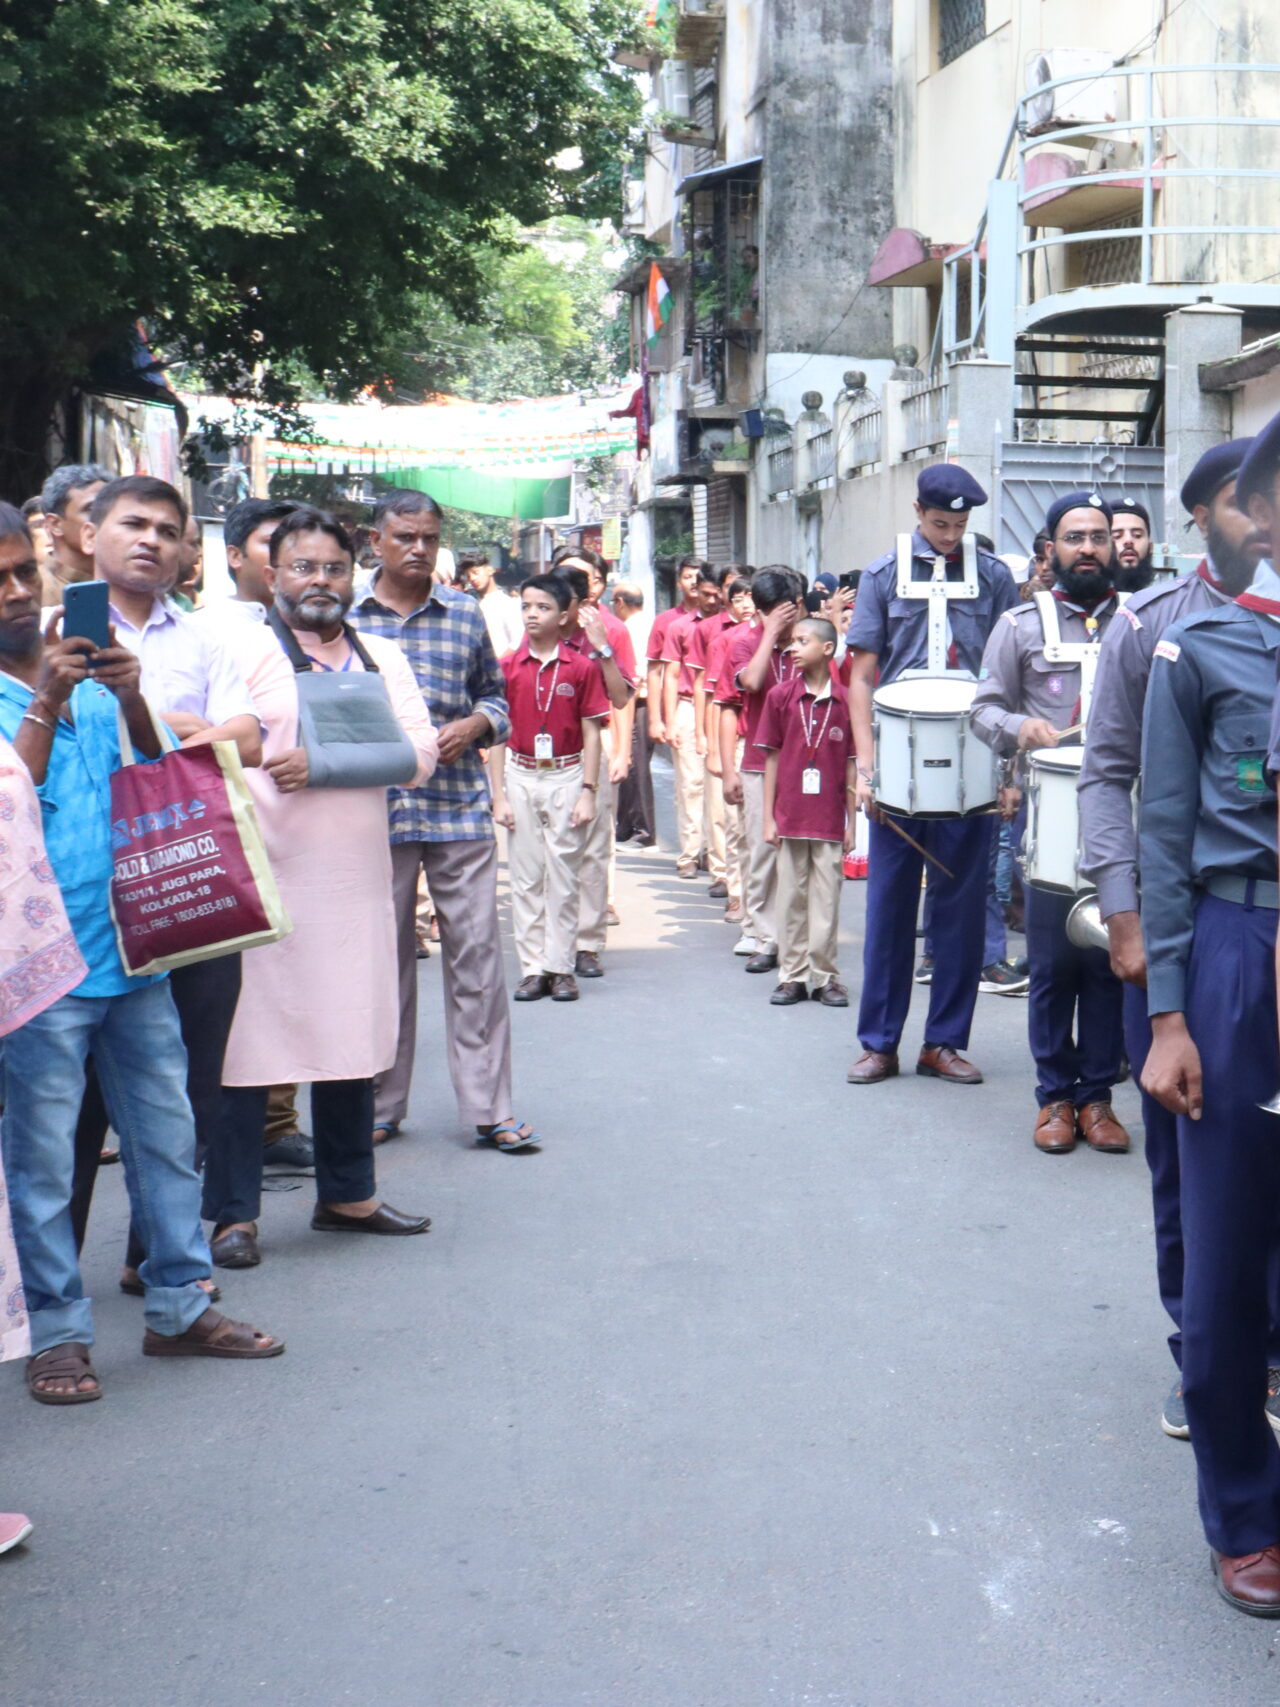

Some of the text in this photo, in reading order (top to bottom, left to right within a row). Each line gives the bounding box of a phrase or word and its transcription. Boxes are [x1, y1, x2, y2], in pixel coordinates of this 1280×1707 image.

[140, 856, 151, 875] &
[150, 841, 198, 871] DIAMOND
[199, 835, 220, 856] CO.
[160, 874, 188, 892] JUGI
[189, 864, 226, 884] PARA,
[139, 884, 212, 914] KOLKATA-18
